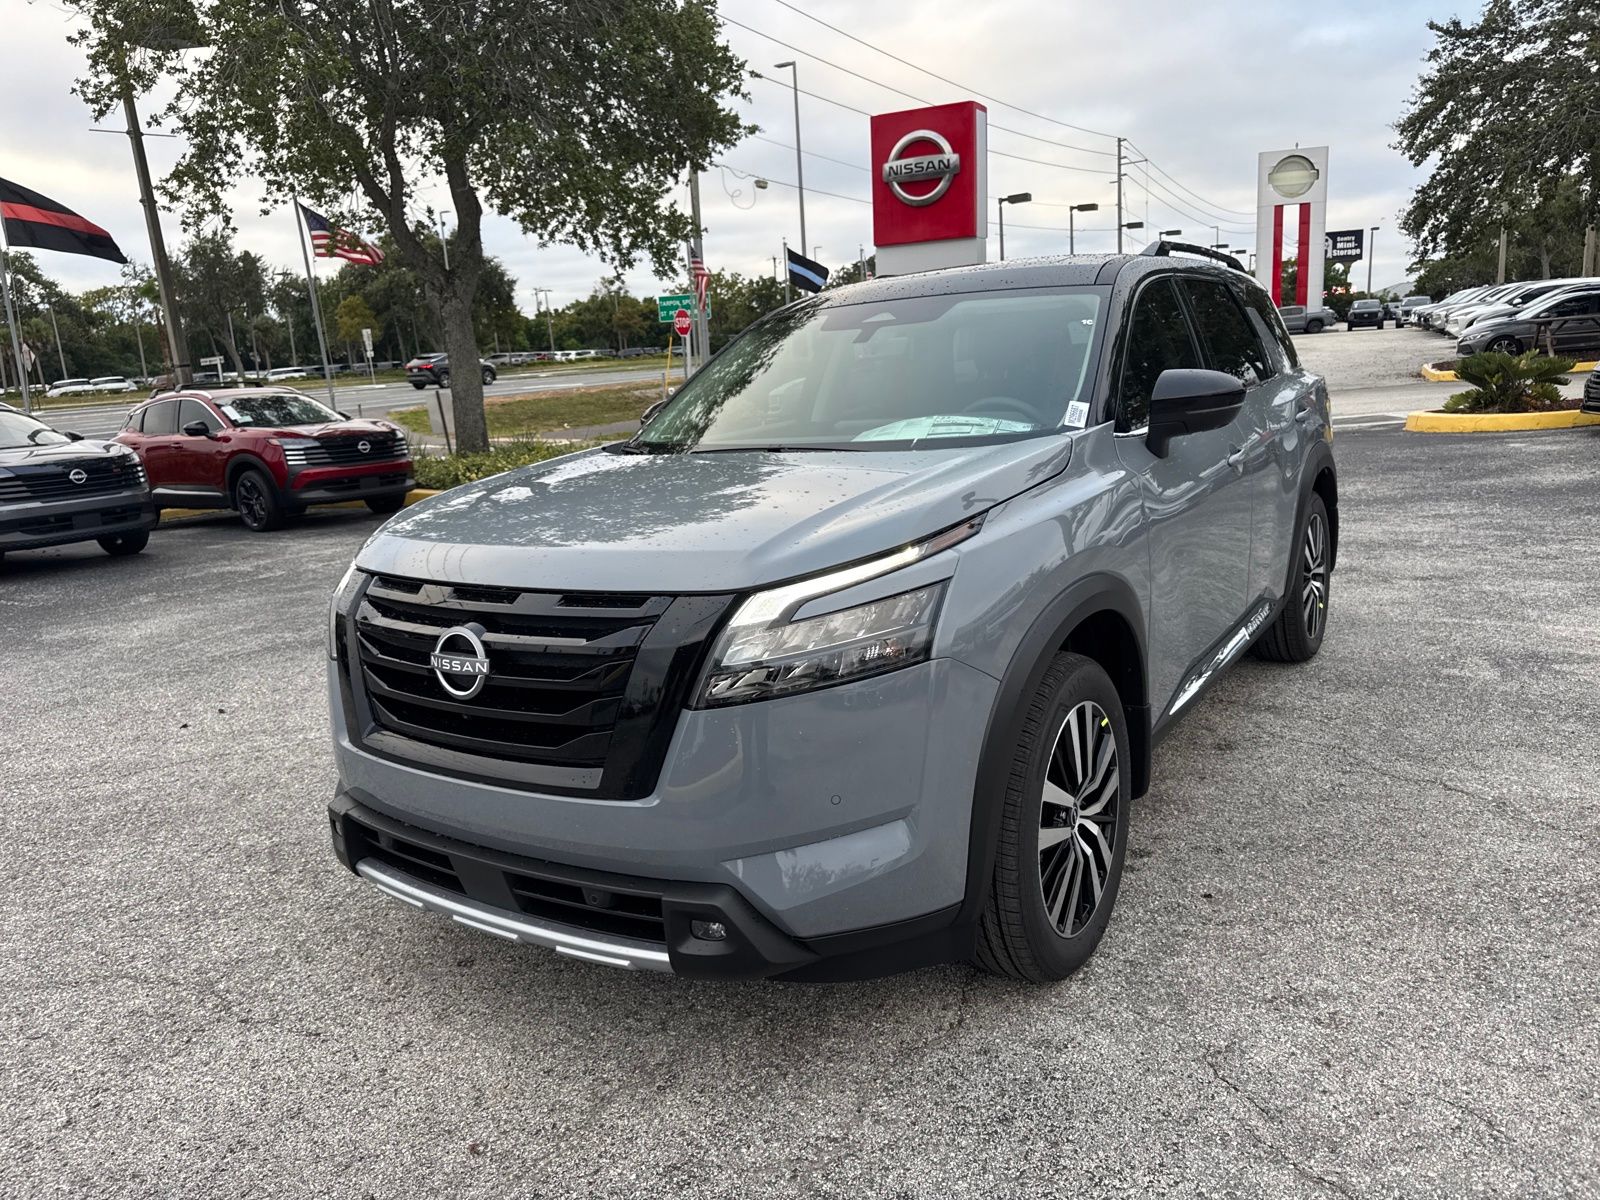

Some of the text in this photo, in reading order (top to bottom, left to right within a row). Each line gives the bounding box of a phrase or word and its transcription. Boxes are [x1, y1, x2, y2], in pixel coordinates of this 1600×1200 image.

[889, 158, 951, 177] NISSAN
[1332, 249, 1361, 257] Storage
[675, 317, 690, 328] STOP
[430, 655, 488, 673] NISSAN
